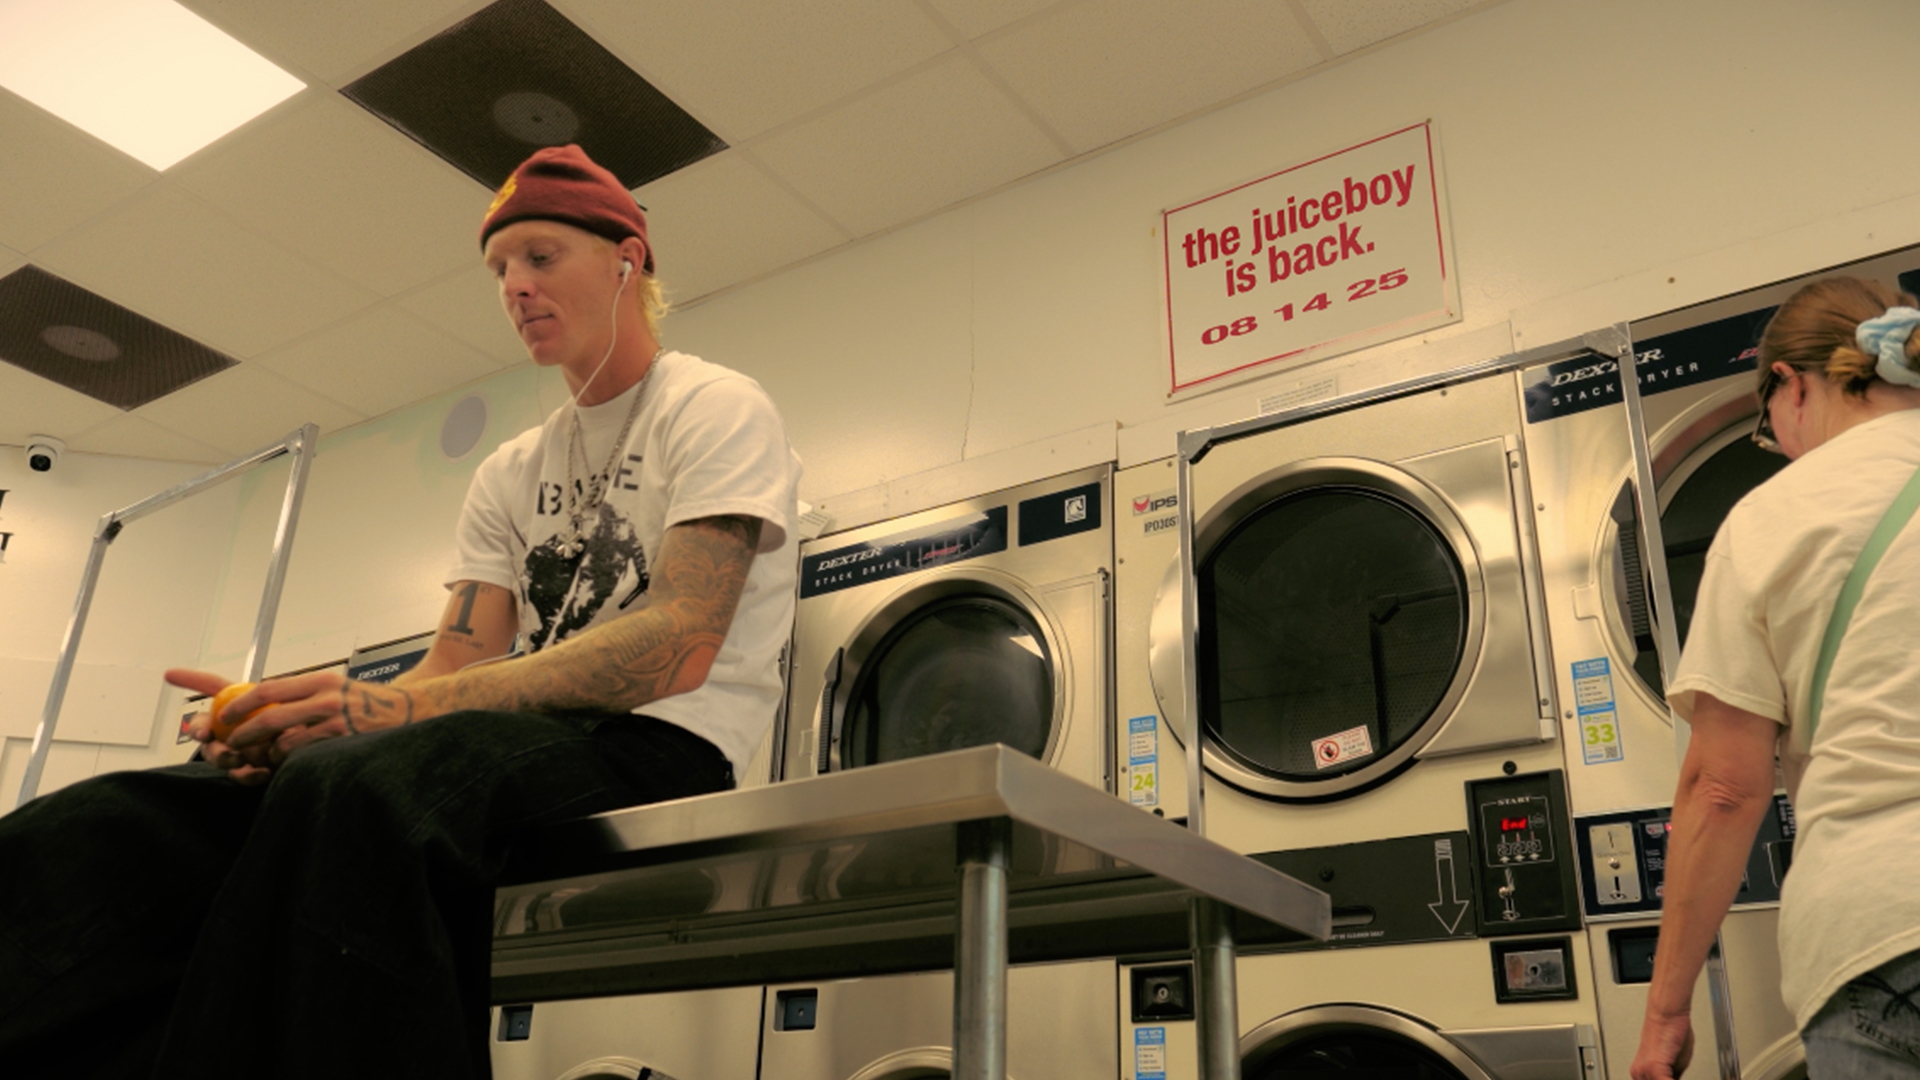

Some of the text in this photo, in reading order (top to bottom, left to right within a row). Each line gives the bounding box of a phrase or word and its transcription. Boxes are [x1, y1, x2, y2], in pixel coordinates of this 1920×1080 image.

[1181, 164, 1415, 269] the juiceboy
[1224, 222, 1375, 299] is back.
[1200, 267, 1410, 347] 08 14 25
[1552, 383, 1616, 407] STACK
[816, 546, 884, 573] DEXTER
[815, 559, 901, 588] STACK DRYER
[1585, 723, 1616, 745] 33
[1132, 772, 1155, 791] 24
[1497, 796, 1531, 806] START
[1500, 817, 1528, 832] End
